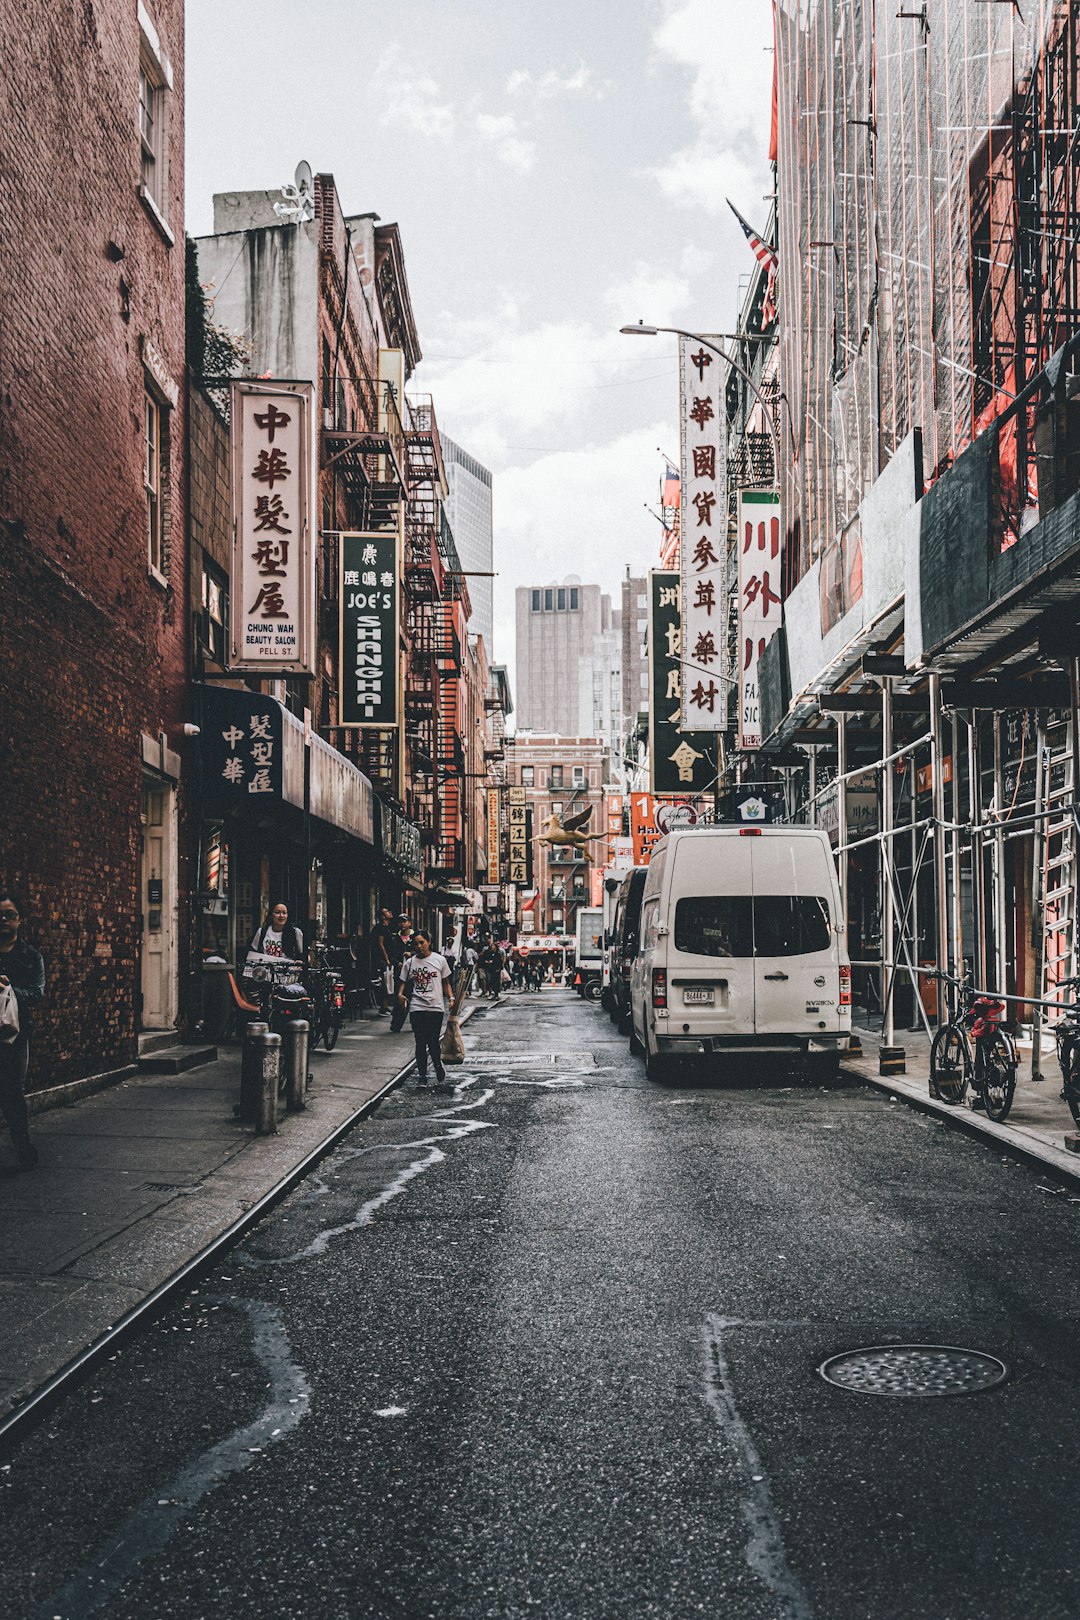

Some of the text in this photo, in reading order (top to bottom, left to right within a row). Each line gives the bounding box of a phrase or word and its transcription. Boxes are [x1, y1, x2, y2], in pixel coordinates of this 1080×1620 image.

[248, 403, 293, 620] 中華髮型屋
[344, 570, 395, 587] 鹿鳴春
[347, 591, 392, 609] JOE'S
[247, 623, 294, 633] CHUNG WAH
[246, 635, 296, 645] BEAUTY SALON
[259, 647, 278, 655] PELL
[355, 615, 384, 717] SHANGHAI
[744, 683, 760, 699] FA
[744, 706, 761, 723] SIC
[221, 724, 246, 784] 中華
[248, 714, 274, 793] 髮型屋
